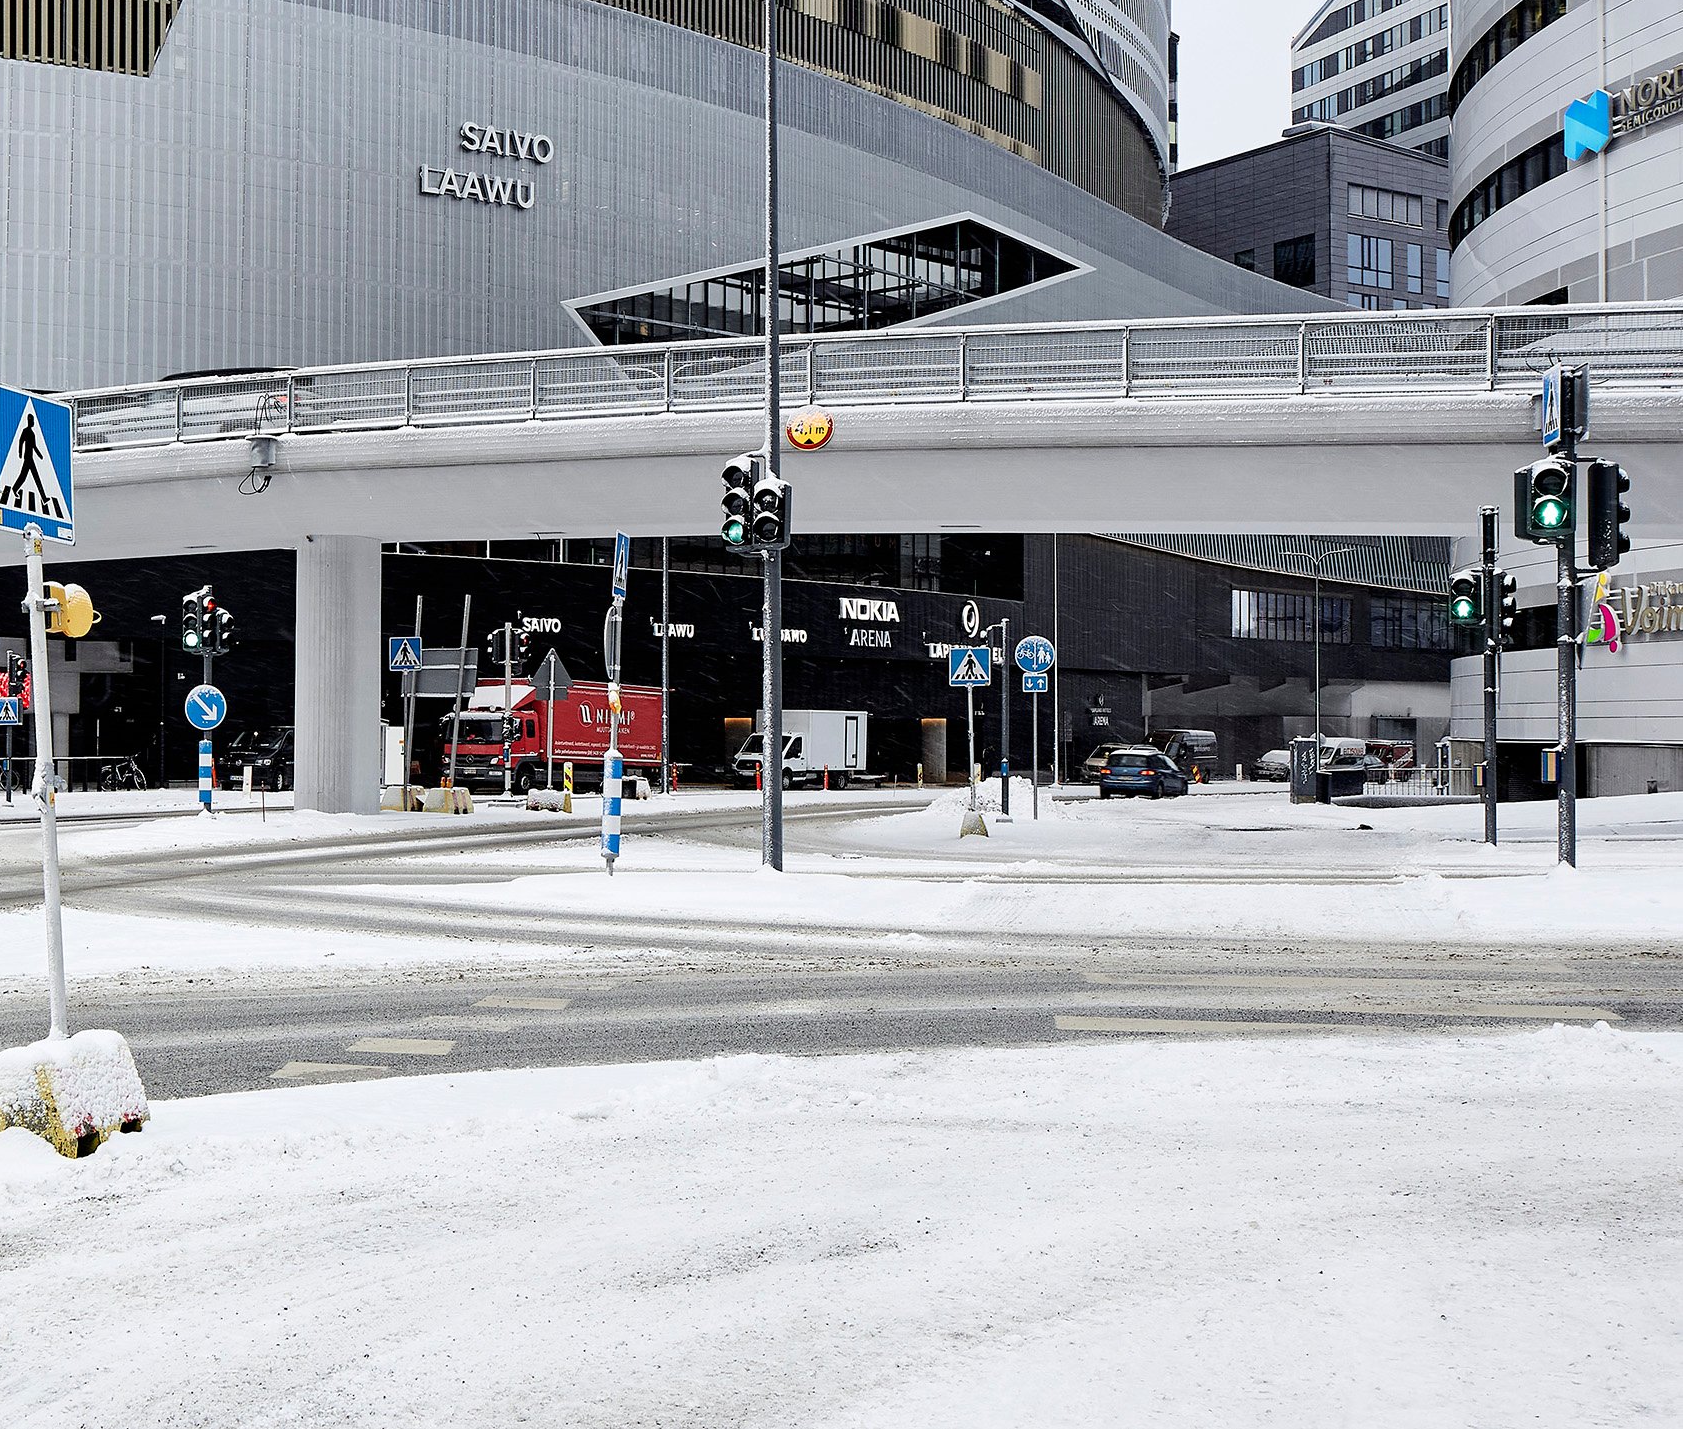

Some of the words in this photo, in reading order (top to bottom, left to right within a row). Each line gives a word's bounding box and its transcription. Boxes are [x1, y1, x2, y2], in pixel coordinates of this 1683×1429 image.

[460, 121, 555, 164] SAIVO
[419, 163, 535, 209] LAAWU
[839, 598, 900, 623] NOKIA
[522, 617, 561, 633] SAIVO
[849, 628, 892, 648] ARENA
